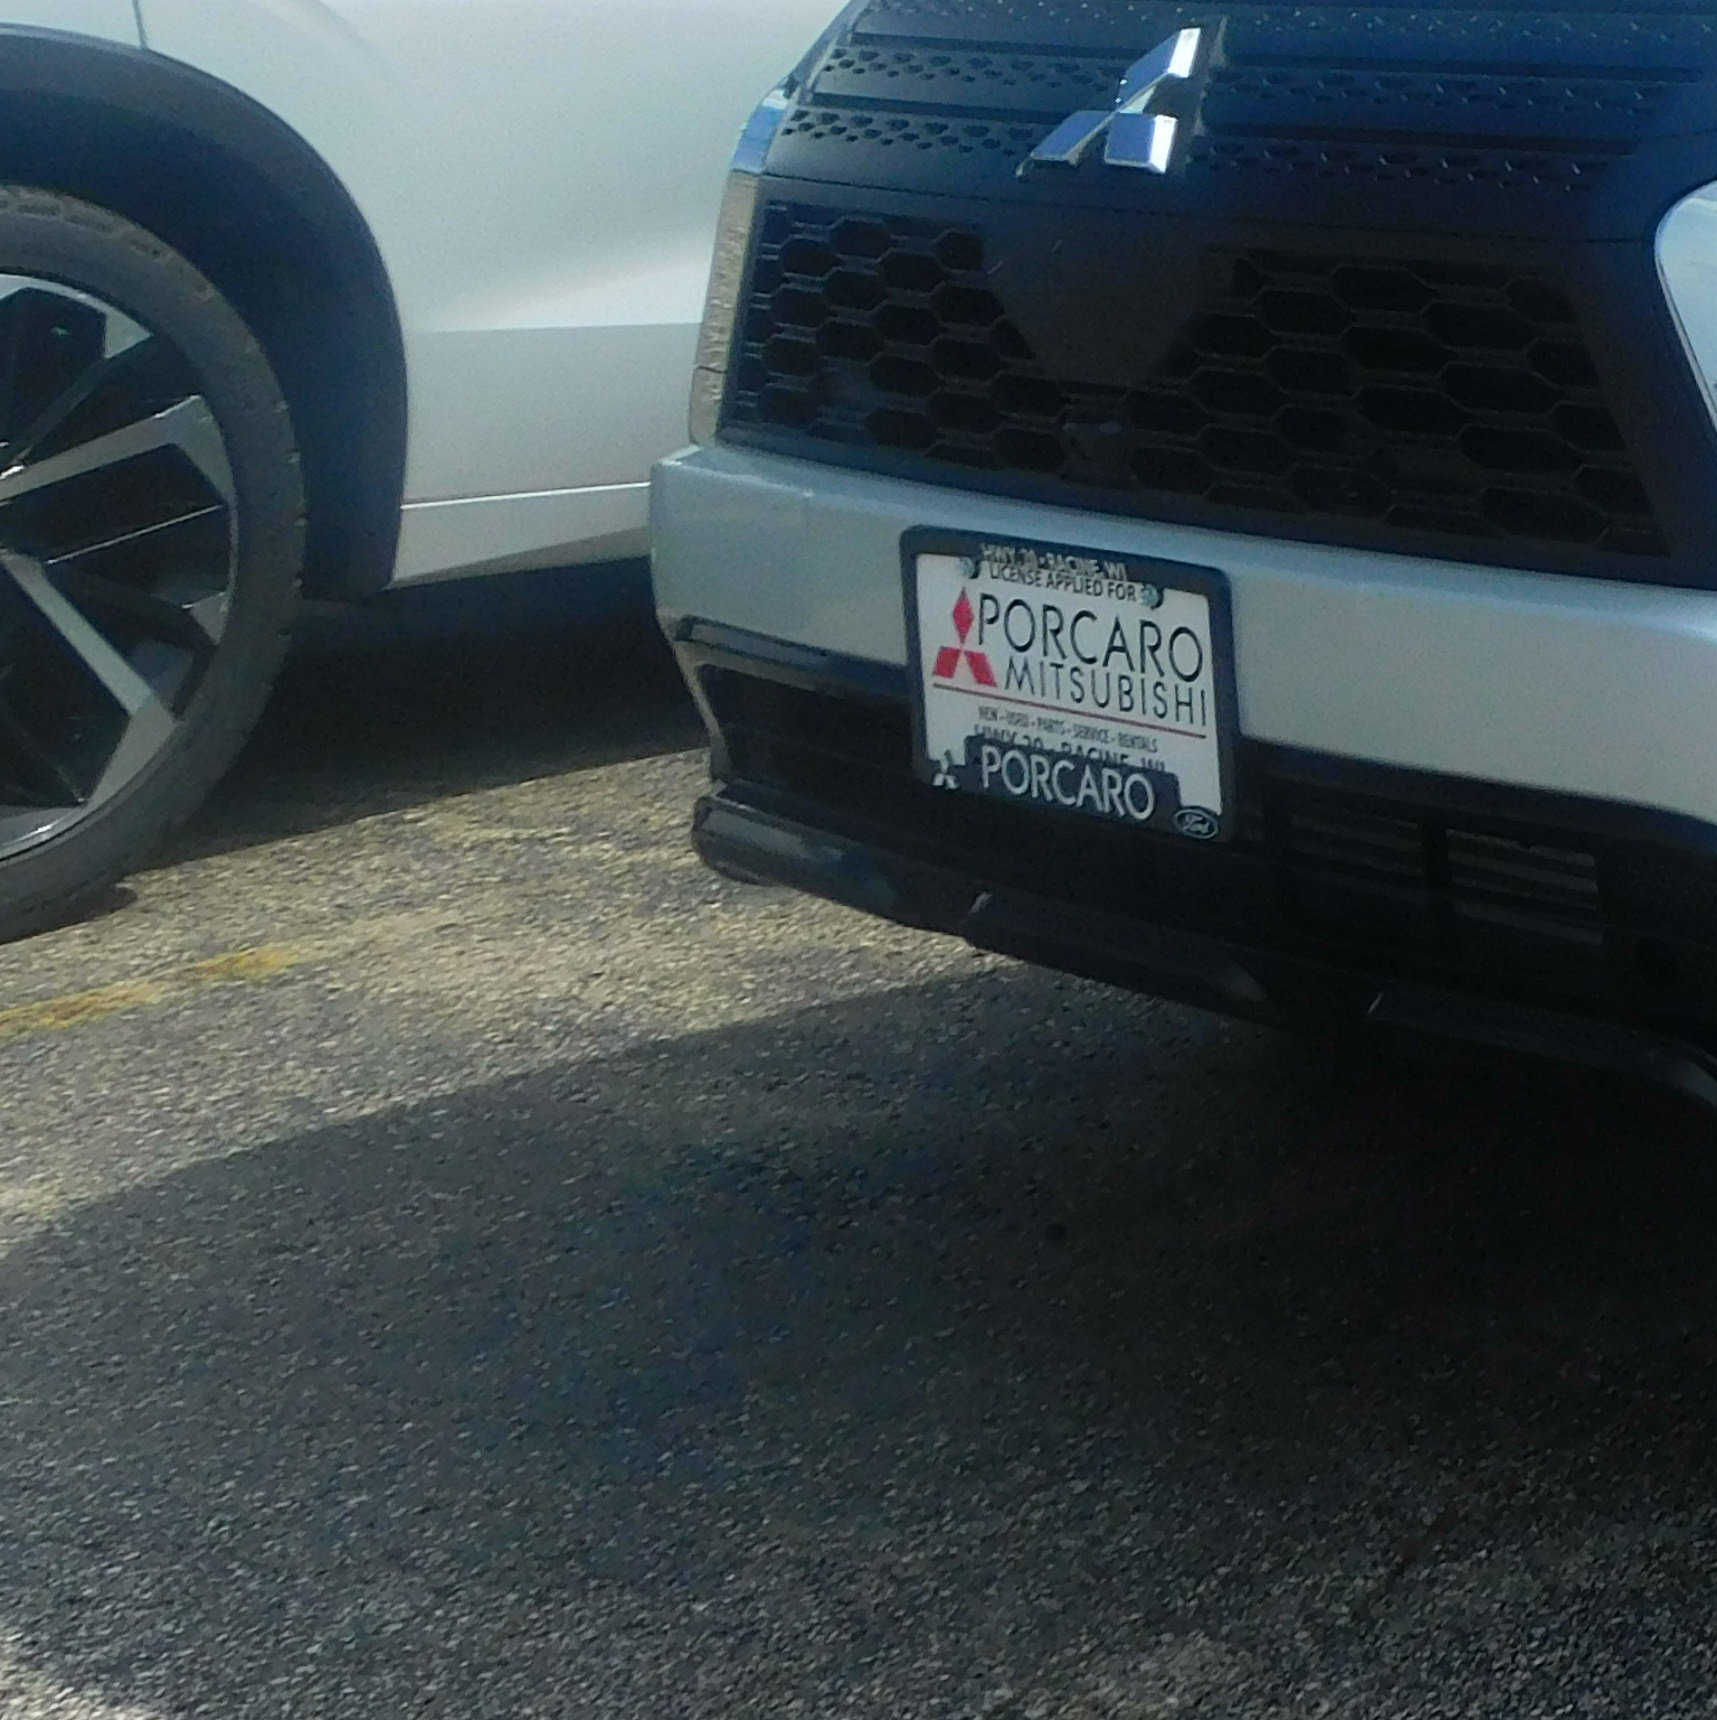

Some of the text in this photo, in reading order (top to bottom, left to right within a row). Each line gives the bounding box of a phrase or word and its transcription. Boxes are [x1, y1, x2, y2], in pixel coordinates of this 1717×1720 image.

[990, 561, 1138, 602] LICENSE APPLIED FOR
[978, 592, 1203, 683] PORCARO
[1005, 655, 1207, 727] MITSUBISHI
[981, 744, 1156, 821] PORCARO
